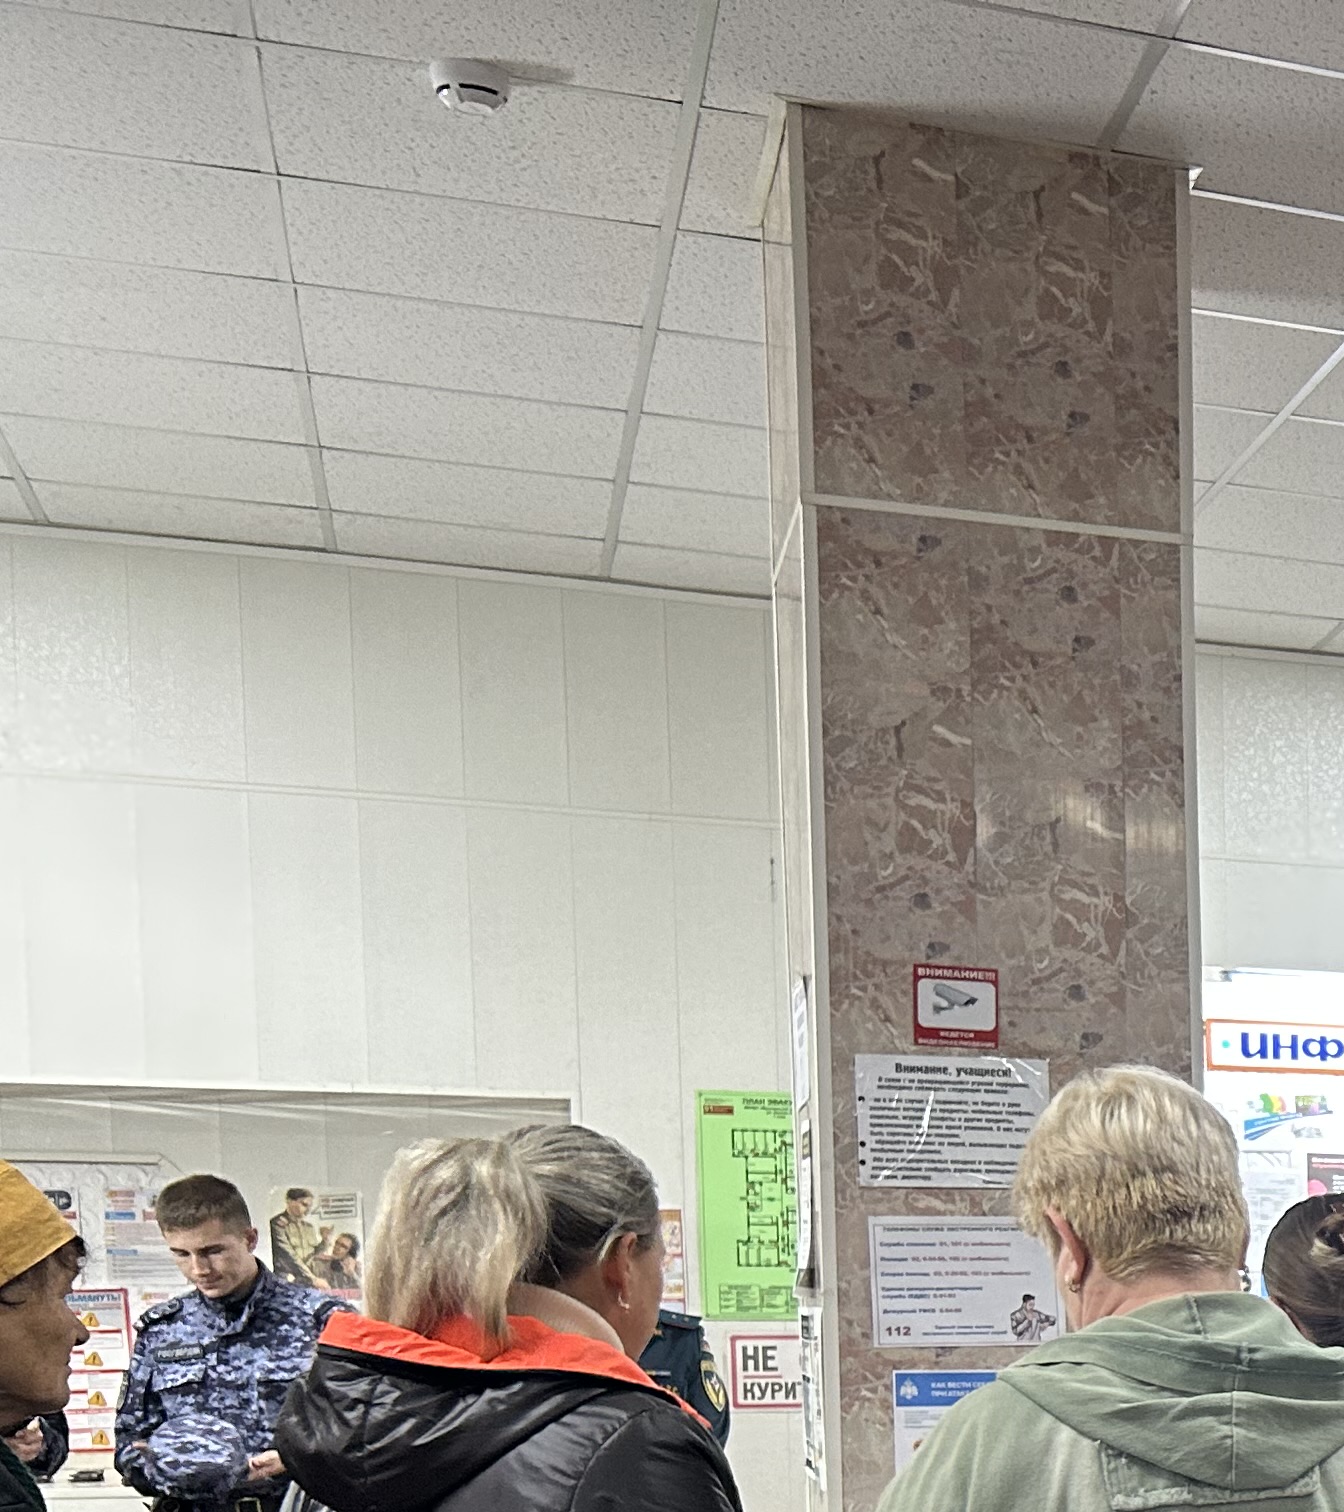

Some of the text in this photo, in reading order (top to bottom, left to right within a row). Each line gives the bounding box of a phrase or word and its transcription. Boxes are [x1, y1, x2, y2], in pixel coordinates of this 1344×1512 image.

[917, 967, 996, 980] ВНИМАНИЕ!!!
[895, 1062, 1012, 1078] Внимание, учащиеся!
[885, 1326, 911, 1337] 112
[741, 1345, 778, 1372] НЕ
